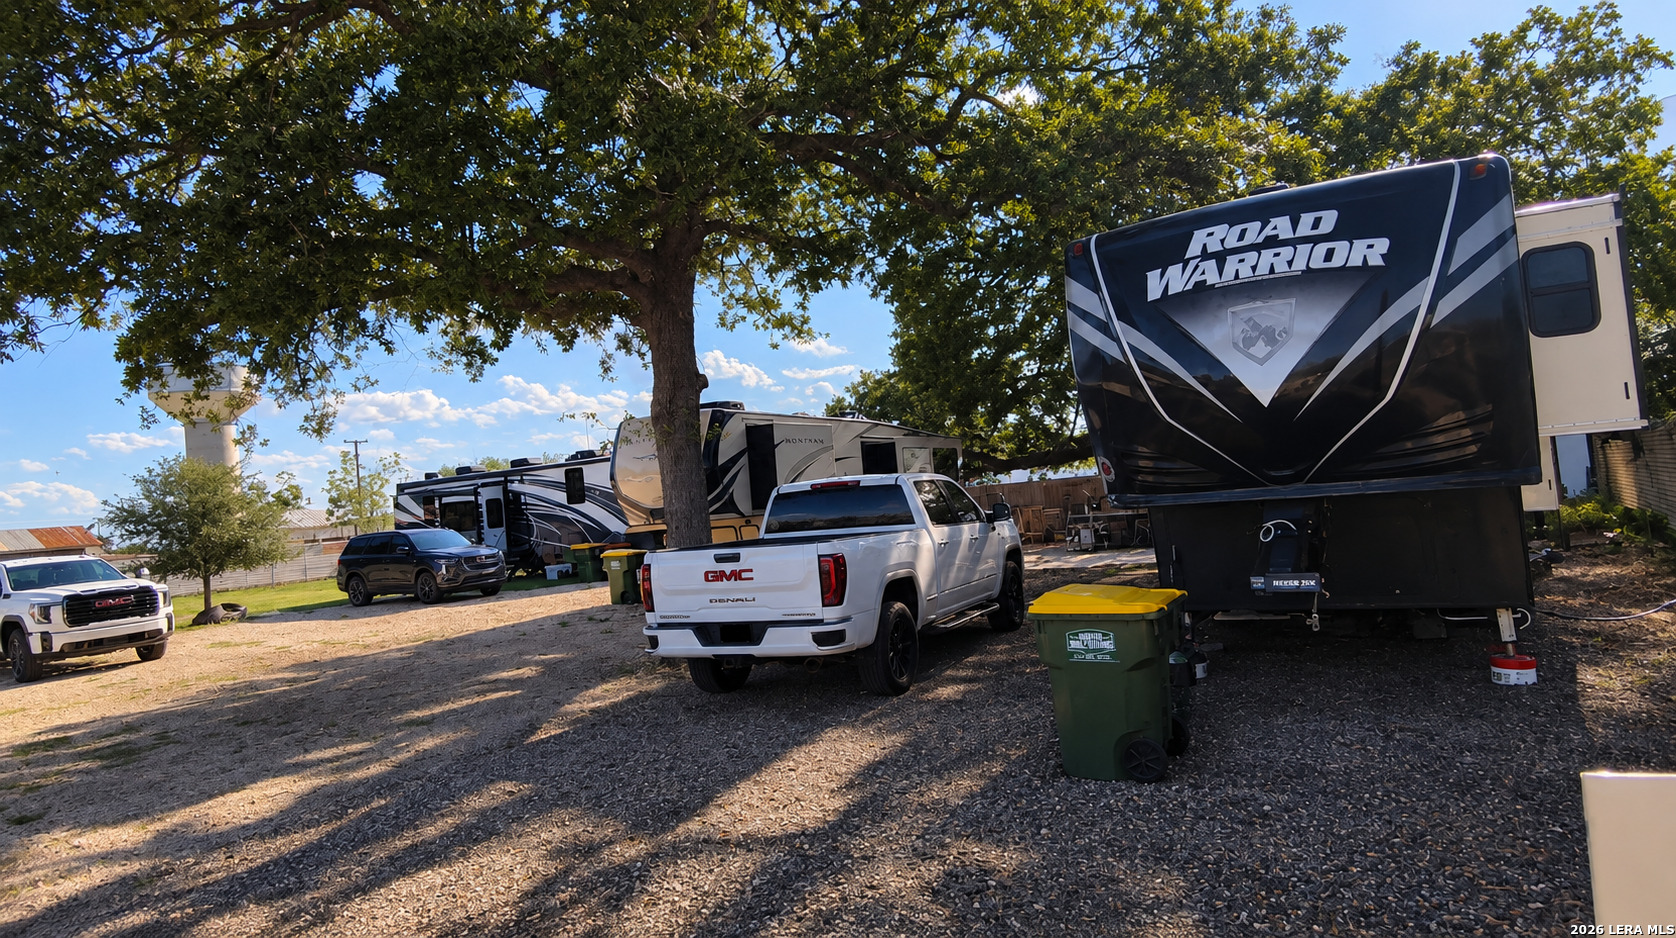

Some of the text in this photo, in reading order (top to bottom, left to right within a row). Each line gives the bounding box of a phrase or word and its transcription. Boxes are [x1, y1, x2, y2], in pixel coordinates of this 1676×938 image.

[1184, 209, 1339, 259] ROAD
[1145, 237, 1391, 302] WARRIOR
[704, 568, 754, 582] GMC
[95, 596, 132, 607] GMC
